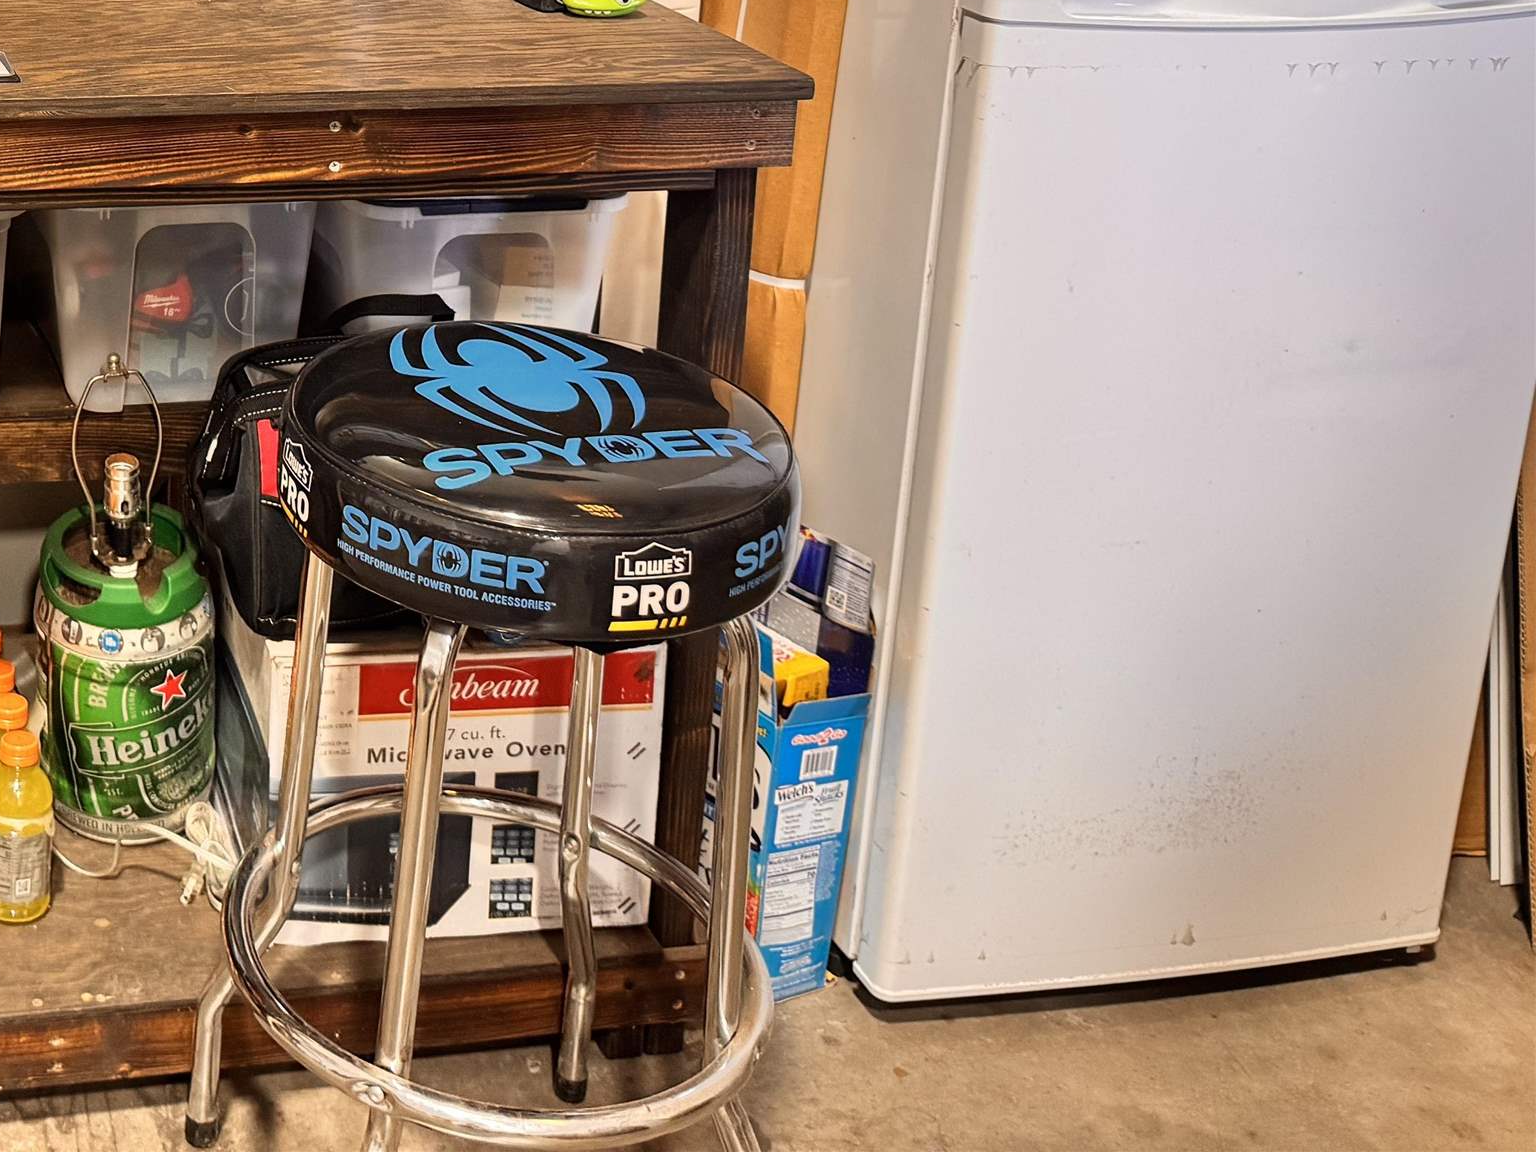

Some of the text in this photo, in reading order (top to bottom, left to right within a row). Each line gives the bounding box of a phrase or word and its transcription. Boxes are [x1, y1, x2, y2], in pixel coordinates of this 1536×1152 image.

[422, 427, 771, 490] SPYDER
[280, 463, 310, 522] PRO
[341, 504, 547, 595] SPYDER
[336, 538, 554, 612] HIGH PERFORMANCE POWER TOOL ACCESSORIES
[610, 581, 691, 617] PRO
[86, 696, 212, 766] Heinek
[366, 742, 566, 765] Micave Oven
[459, 728, 484, 741] cu.
[490, 725, 506, 740] ft.
[777, 784, 814, 803] Welch's
[101, 821, 113, 833] IN
